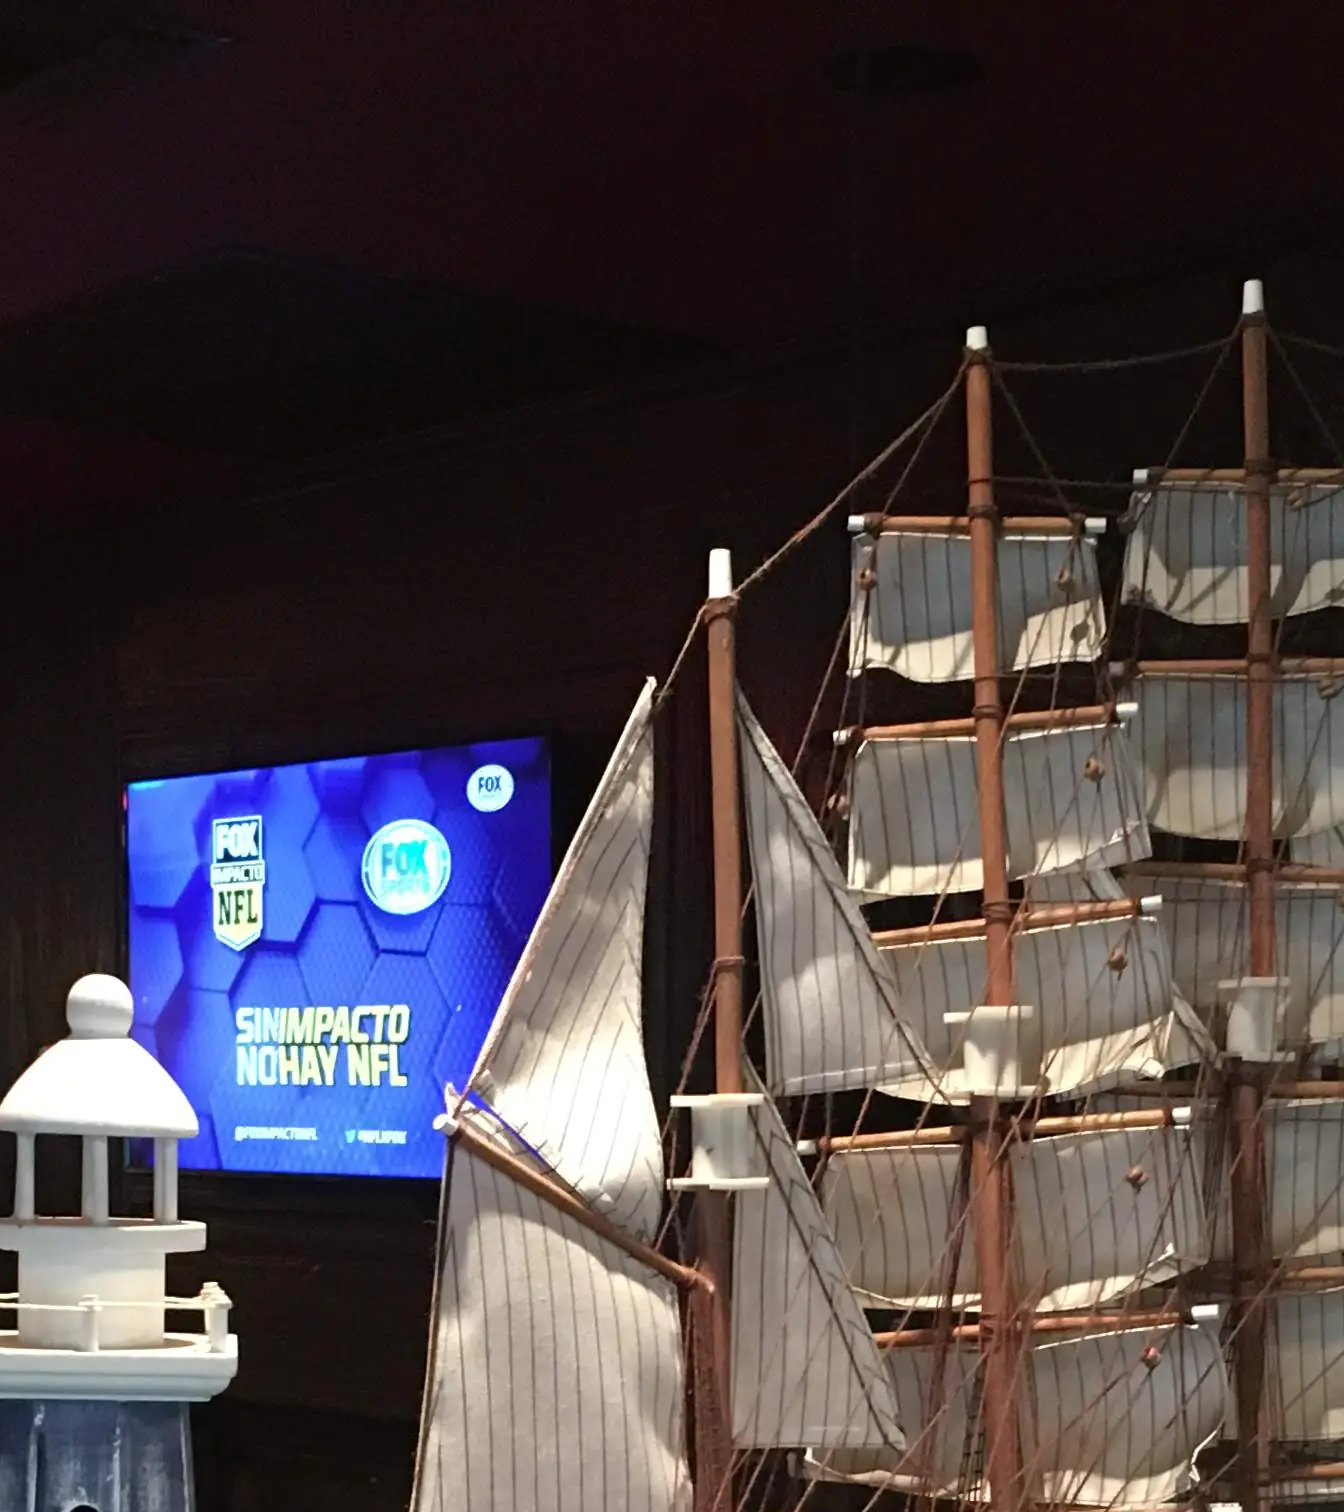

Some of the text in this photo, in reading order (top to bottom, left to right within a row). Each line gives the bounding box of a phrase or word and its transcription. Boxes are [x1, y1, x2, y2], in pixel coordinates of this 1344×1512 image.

[478, 775, 502, 794] FOX
[216, 821, 258, 859] FOX
[382, 840, 429, 877] FOX
[218, 888, 258, 925] NFL
[347, 1044, 408, 1086] NFL
